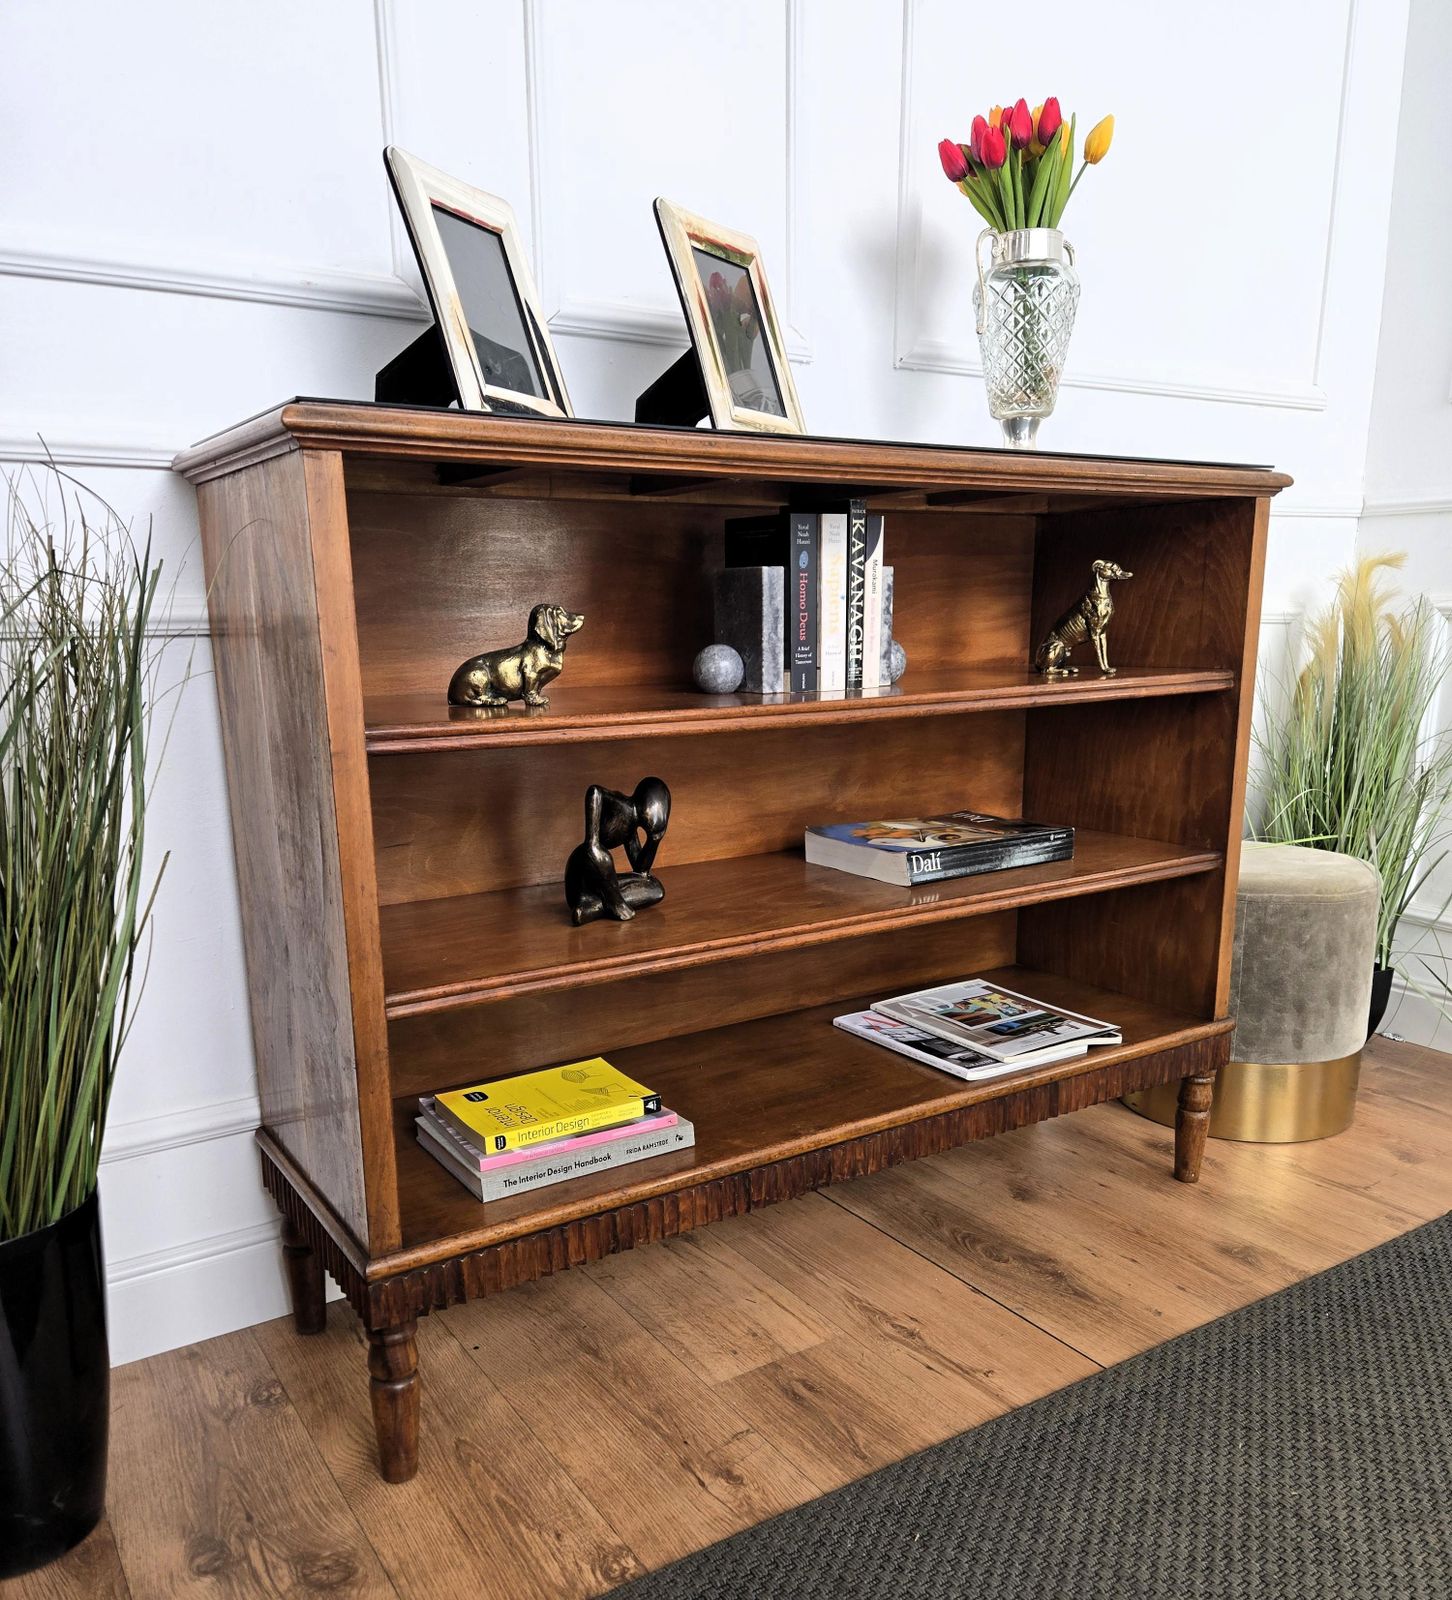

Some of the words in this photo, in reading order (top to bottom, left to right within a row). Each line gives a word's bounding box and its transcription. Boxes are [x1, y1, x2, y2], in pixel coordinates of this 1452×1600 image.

[799, 573, 809, 610] Homo
[850, 518, 865, 661] KAVANAGH
[799, 612, 809, 641] Deus
[911, 851, 942, 874] Dalí
[518, 1127, 554, 1142] Interior
[556, 1116, 590, 1133] Design
[503, 1179, 518, 1188] The
[519, 1171, 547, 1184] Interior
[547, 1165, 573, 1177] Design
[574, 1153, 612, 1169] Handbook
